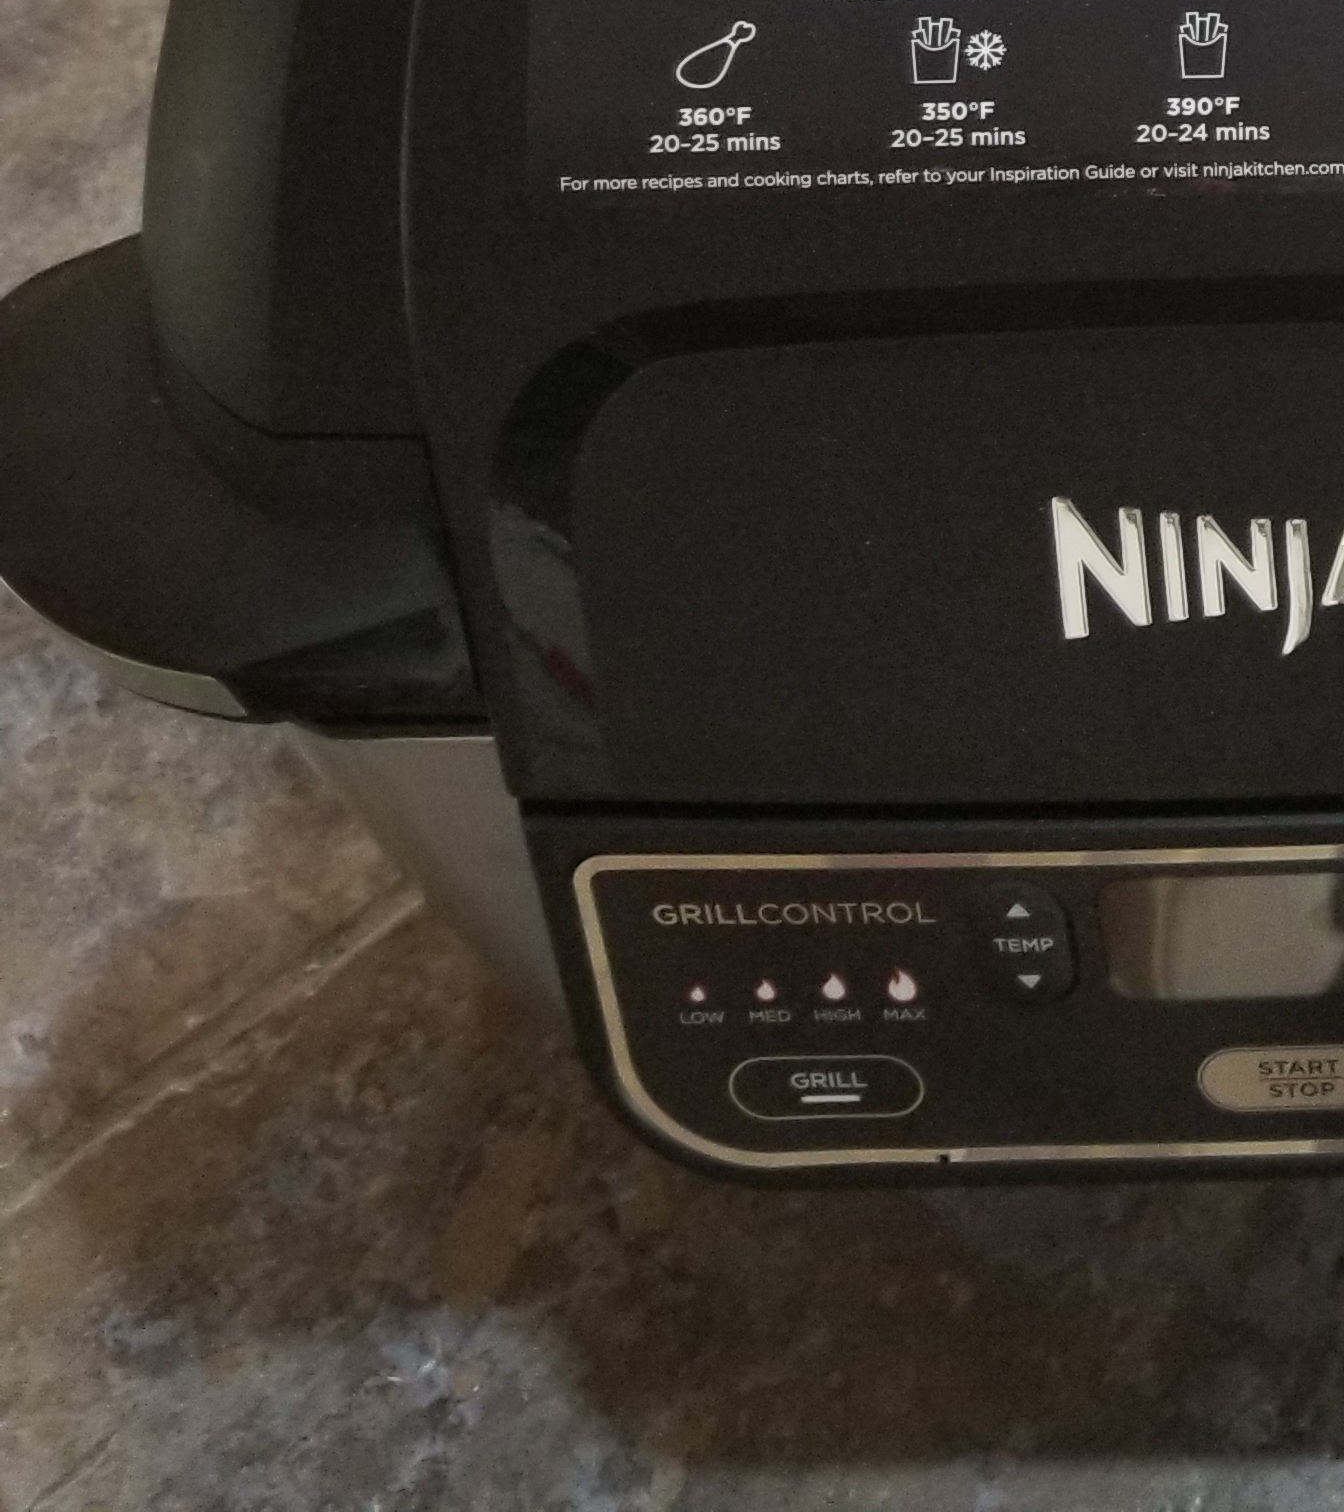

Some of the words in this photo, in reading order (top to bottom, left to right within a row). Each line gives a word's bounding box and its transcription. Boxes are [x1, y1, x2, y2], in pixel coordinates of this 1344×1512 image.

[921, 101, 995, 121] 350°F
[1166, 96, 1240, 117] 390°F
[679, 106, 752, 127] 360°F
[891, 127, 964, 148] 20-25
[971, 126, 1026, 146] mins
[1136, 122, 1209, 143] 20-24
[1215, 121, 1271, 141] mins
[649, 133, 720, 154] 20-25
[726, 132, 781, 152] mins
[560, 176, 590, 192] For
[593, 178, 638, 191] more
[641, 174, 704, 192] recipes
[707, 172, 740, 188] and
[743, 171, 812, 189] cooking
[816, 170, 874, 186] charts,
[878, 168, 920, 184] refer
[922, 168, 942, 183] to
[945, 170, 986, 185] your
[990, 165, 1080, 184] Inspiration
[1084, 164, 1136, 180] Guide
[1139, 166, 1159, 179] or
[1163, 162, 1199, 178] visit
[652, 901, 937, 926] GRILLCONTROL
[993, 937, 1054, 953] TEMP
[679, 1011, 725, 1025] LOW
[749, 1009, 791, 1023] MED
[813, 1008, 862, 1022] HIGH
[883, 1008, 925, 1021] MAX
[1258, 1059, 1339, 1076] START
[790, 1071, 868, 1089] GRILL
[1269, 1081, 1336, 1098] STOP
